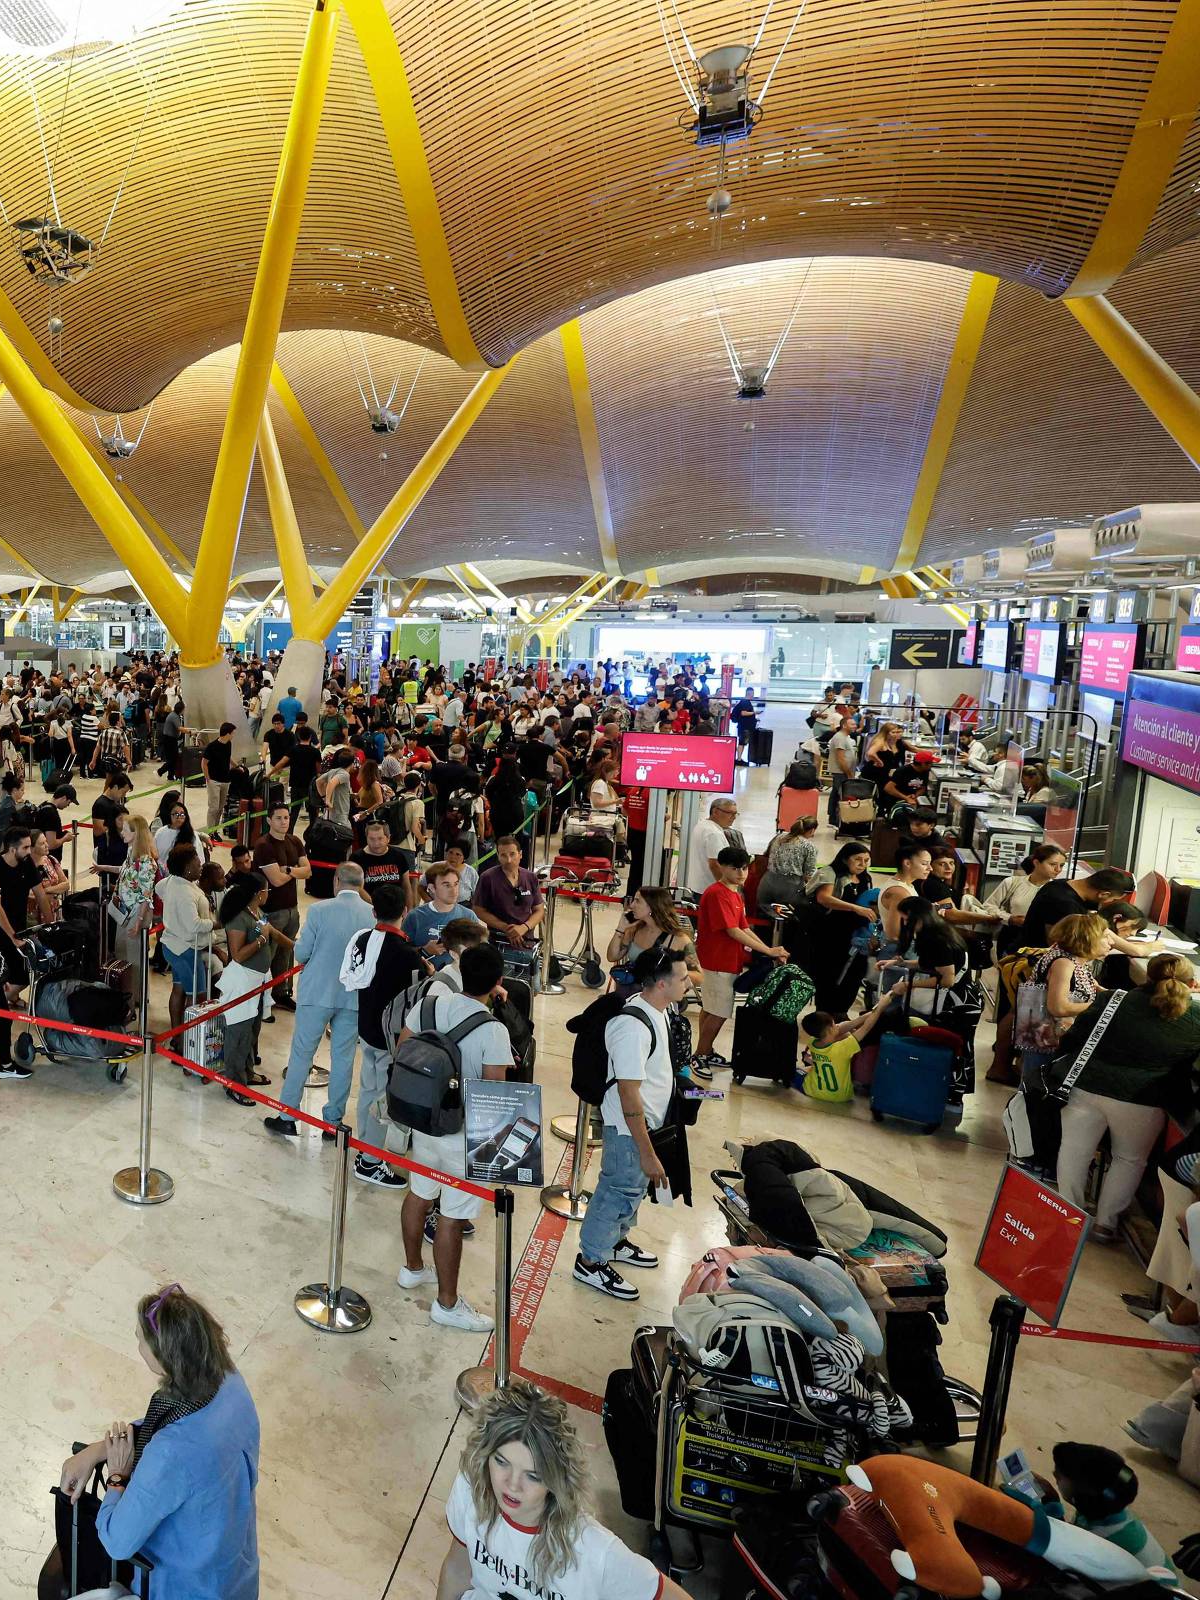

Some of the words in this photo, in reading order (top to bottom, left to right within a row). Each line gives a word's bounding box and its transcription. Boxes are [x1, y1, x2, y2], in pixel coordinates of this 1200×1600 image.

[1133, 713, 1160, 737] Atención
[1161, 721, 1169, 739] al
[1168, 721, 1193, 747] cliente
[1193, 734, 1200, 754] y
[1130, 740, 1158, 765] Customer
[1157, 754, 1180, 775] service
[1179, 762, 1195, 780] and
[1099, 1008, 1113, 1025] LOLA
[1078, 1046, 1092, 1062] LOLA
[813, 1060, 839, 1092] 10
[430, 1171, 452, 1184] IBERIA
[1037, 1192, 1068, 1217] IBERIA
[999, 1227, 1019, 1246] Exit
[1004, 1212, 1036, 1241] Salida
[527, 1238, 545, 1264] ESPERE
[545, 1238, 560, 1256] WAIT
[539, 1254, 554, 1269] FOR
[513, 1279, 529, 1292] SU
[532, 1267, 550, 1288] YOUR
[510, 1291, 525, 1317] TURNO
[525, 1287, 543, 1309] TURN
[517, 1306, 537, 1329] HERE
[706, 1431, 725, 1442] Trolley
[736, 1438, 764, 1451] exclusive
[474, 1539, 512, 1586] Betty
